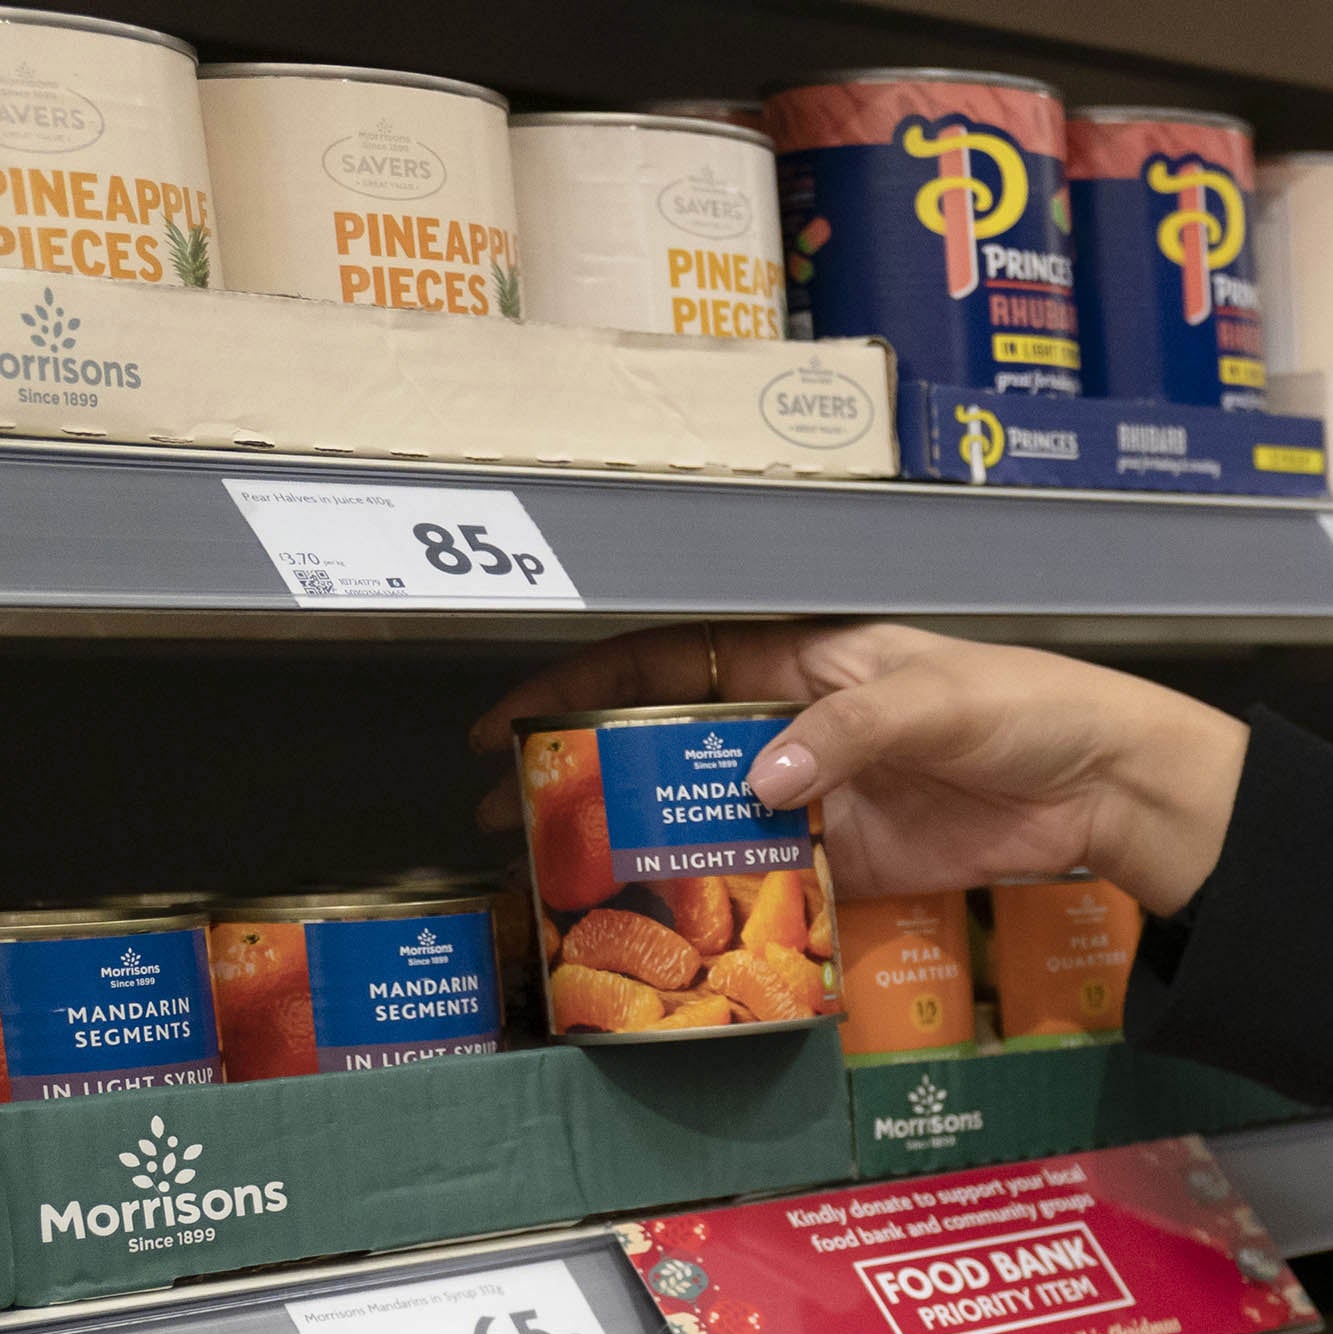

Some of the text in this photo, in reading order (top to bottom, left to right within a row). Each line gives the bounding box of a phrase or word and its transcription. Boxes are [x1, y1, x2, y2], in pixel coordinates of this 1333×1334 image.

[0, 102, 85, 131] AVERS
[341, 153, 432, 181] SAVERS
[0, 164, 211, 238] INEAPPLE
[339, 264, 490, 316] PIECES
[671, 297, 780, 342] PIECES
[0, 352, 142, 389] orrisons
[18, 387, 98, 409] Since 1899
[776, 391, 859, 421] SAVERS
[241, 491, 271, 502] Pear
[273, 492, 316, 505] Halves
[319, 494, 332, 505] in
[333, 495, 364, 507] Juice
[279, 551, 321, 567] £3.70
[412, 521, 545, 586] 85p
[684, 747, 743, 760] Morrisons
[693, 761, 717, 771] Since
[655, 781, 752, 802] MANDAR
[635, 846, 800, 873] IN LIGHT SYRUP
[400, 943, 453, 955] Morrisons
[901, 947, 941, 963] PEAR
[101, 962, 160, 978] Morrisons
[110, 976, 156, 989] Since 1899
[369, 975, 479, 999] MANDARIN
[67, 997, 191, 1025] MANDARIN
[375, 999, 479, 1022] SEGMENTS
[74, 1021, 191, 1048] SEGMENTS
[346, 1054, 372, 1071] IN
[43, 1083, 72, 1100] IN
[874, 1111, 984, 1140] Morrisons
[786, 1163, 1088, 1229] Kindly donate to support your local
[41, 1181, 288, 1243] Morrisons
[811, 1191, 1096, 1254] food bank and community groups
[128, 1228, 217, 1252] Since 1899
[875, 1236, 1098, 1305] FOOD BANK
[304, 1306, 366, 1324] Morrisons
[367, 1295, 429, 1313] Mandarins
[430, 1292, 443, 1304] in
[917, 1276, 1098, 1331] PRIORITY ITEM
